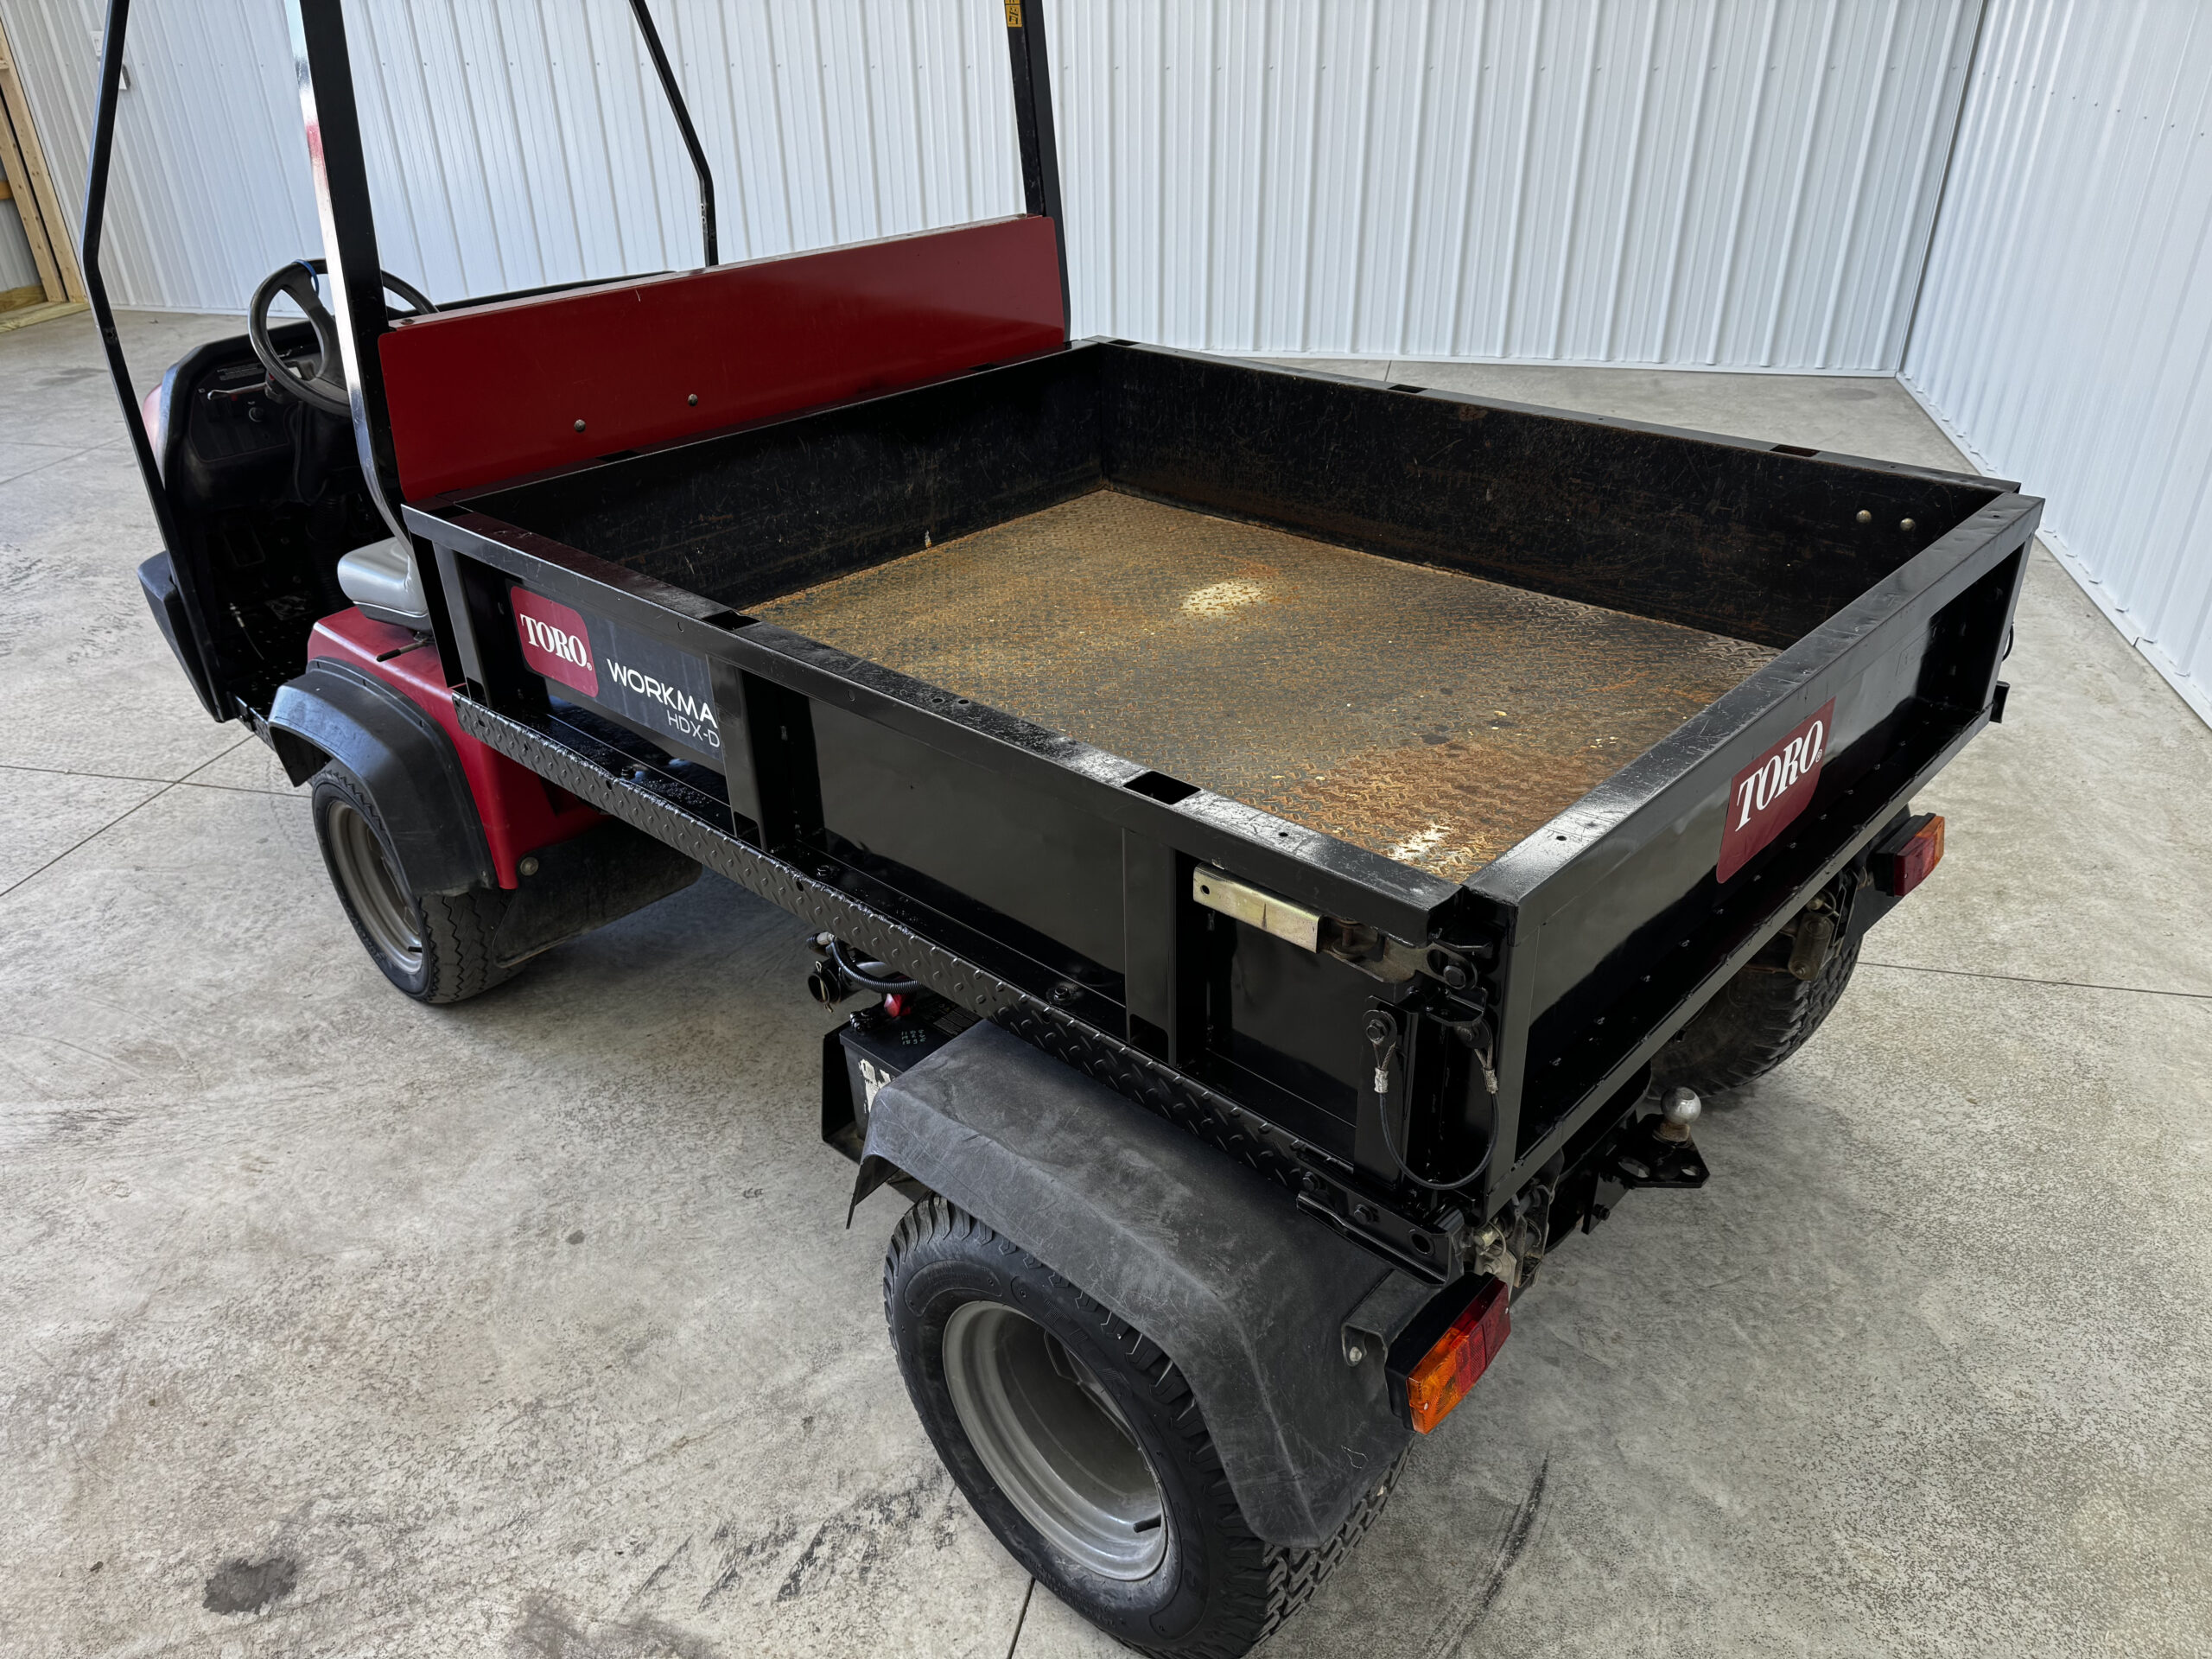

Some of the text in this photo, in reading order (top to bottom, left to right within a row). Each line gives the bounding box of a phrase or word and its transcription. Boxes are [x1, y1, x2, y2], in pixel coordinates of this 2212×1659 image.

[519, 613, 588, 668] TORO
[607, 658, 718, 729] WORKMA
[666, 709, 721, 748] HDX-D
[1735, 719, 1824, 832] TORO
